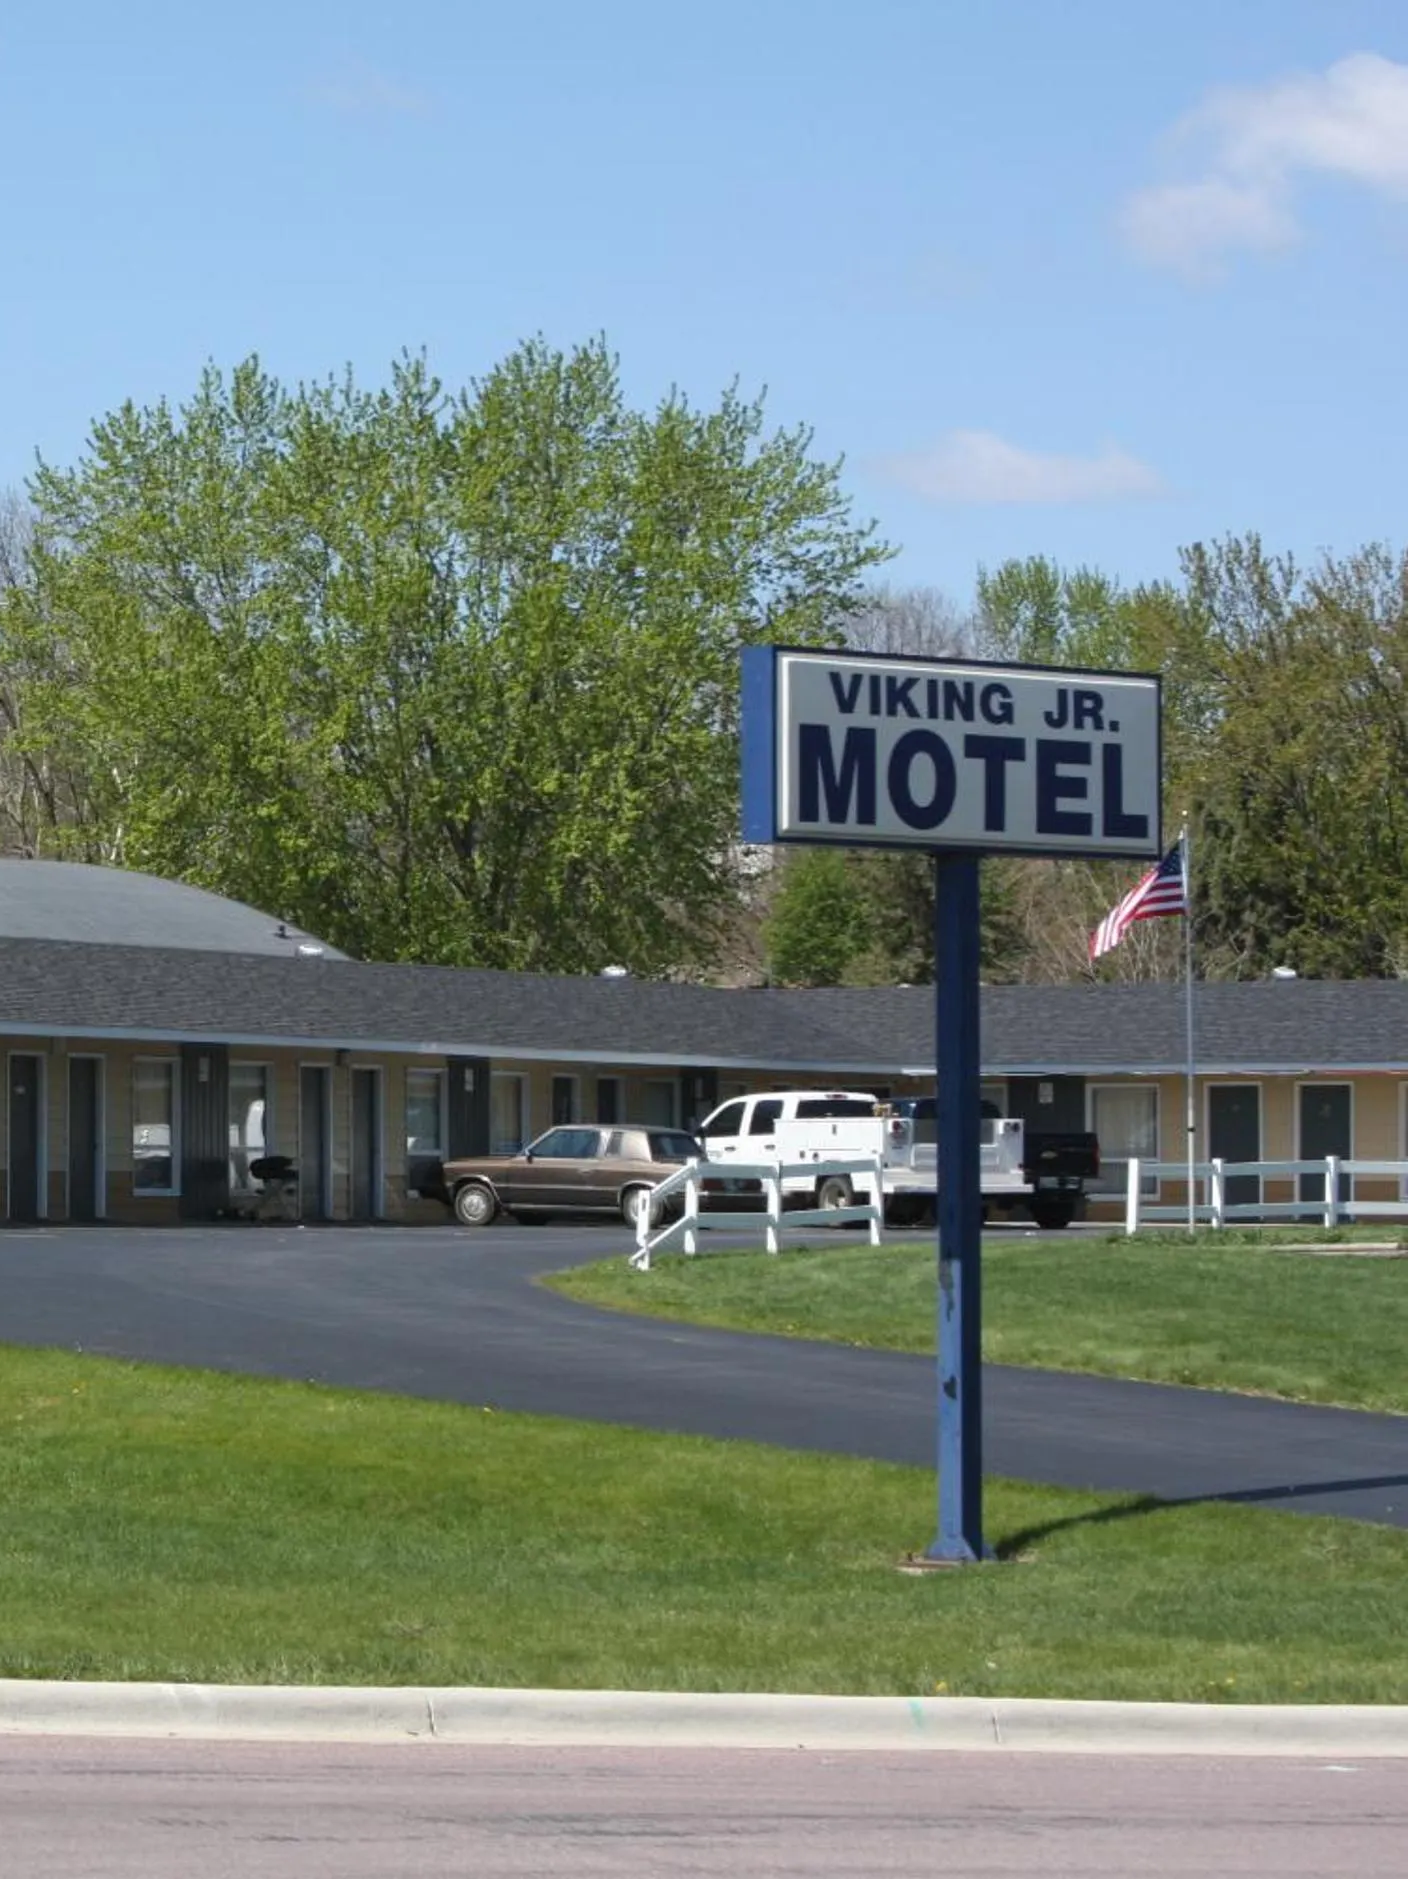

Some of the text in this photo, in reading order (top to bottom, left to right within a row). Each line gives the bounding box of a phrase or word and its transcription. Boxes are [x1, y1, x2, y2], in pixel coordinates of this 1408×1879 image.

[828, 671, 1120, 732] VIKING JR.
[798, 723, 1149, 839] MOTEL
